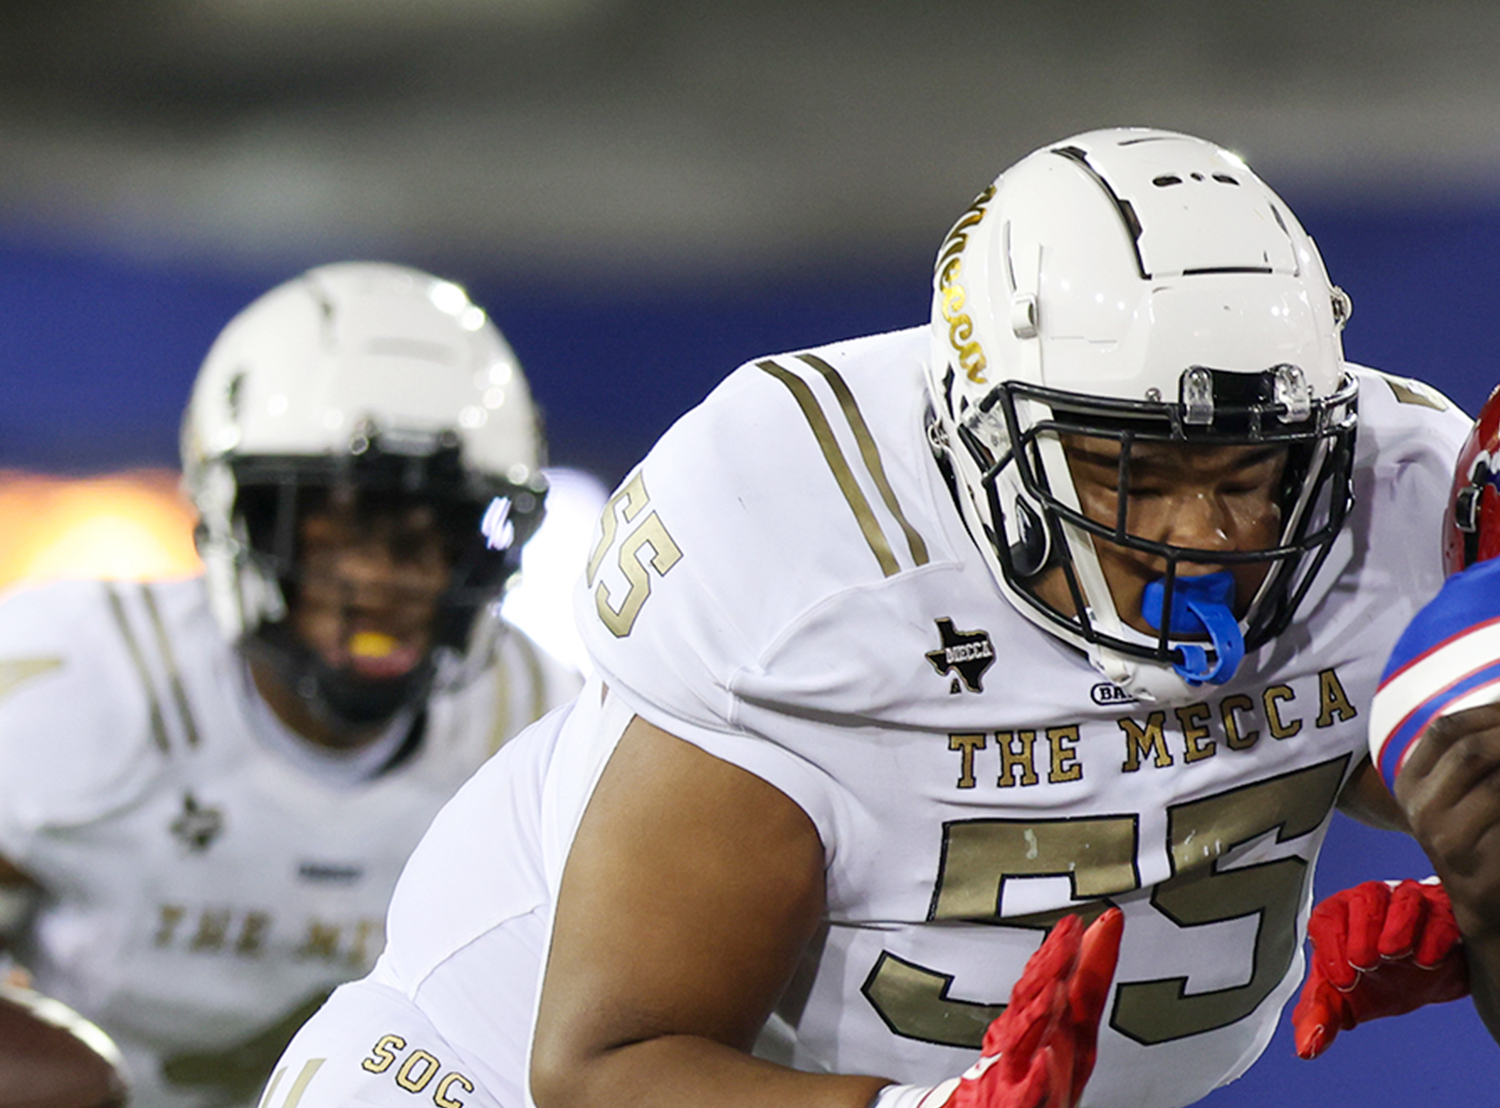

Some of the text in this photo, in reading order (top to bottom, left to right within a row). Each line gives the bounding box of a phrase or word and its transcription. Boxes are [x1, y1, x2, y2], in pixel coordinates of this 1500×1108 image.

[948, 667, 1358, 789] THE MECCA
[860, 752, 1354, 1050] 55
